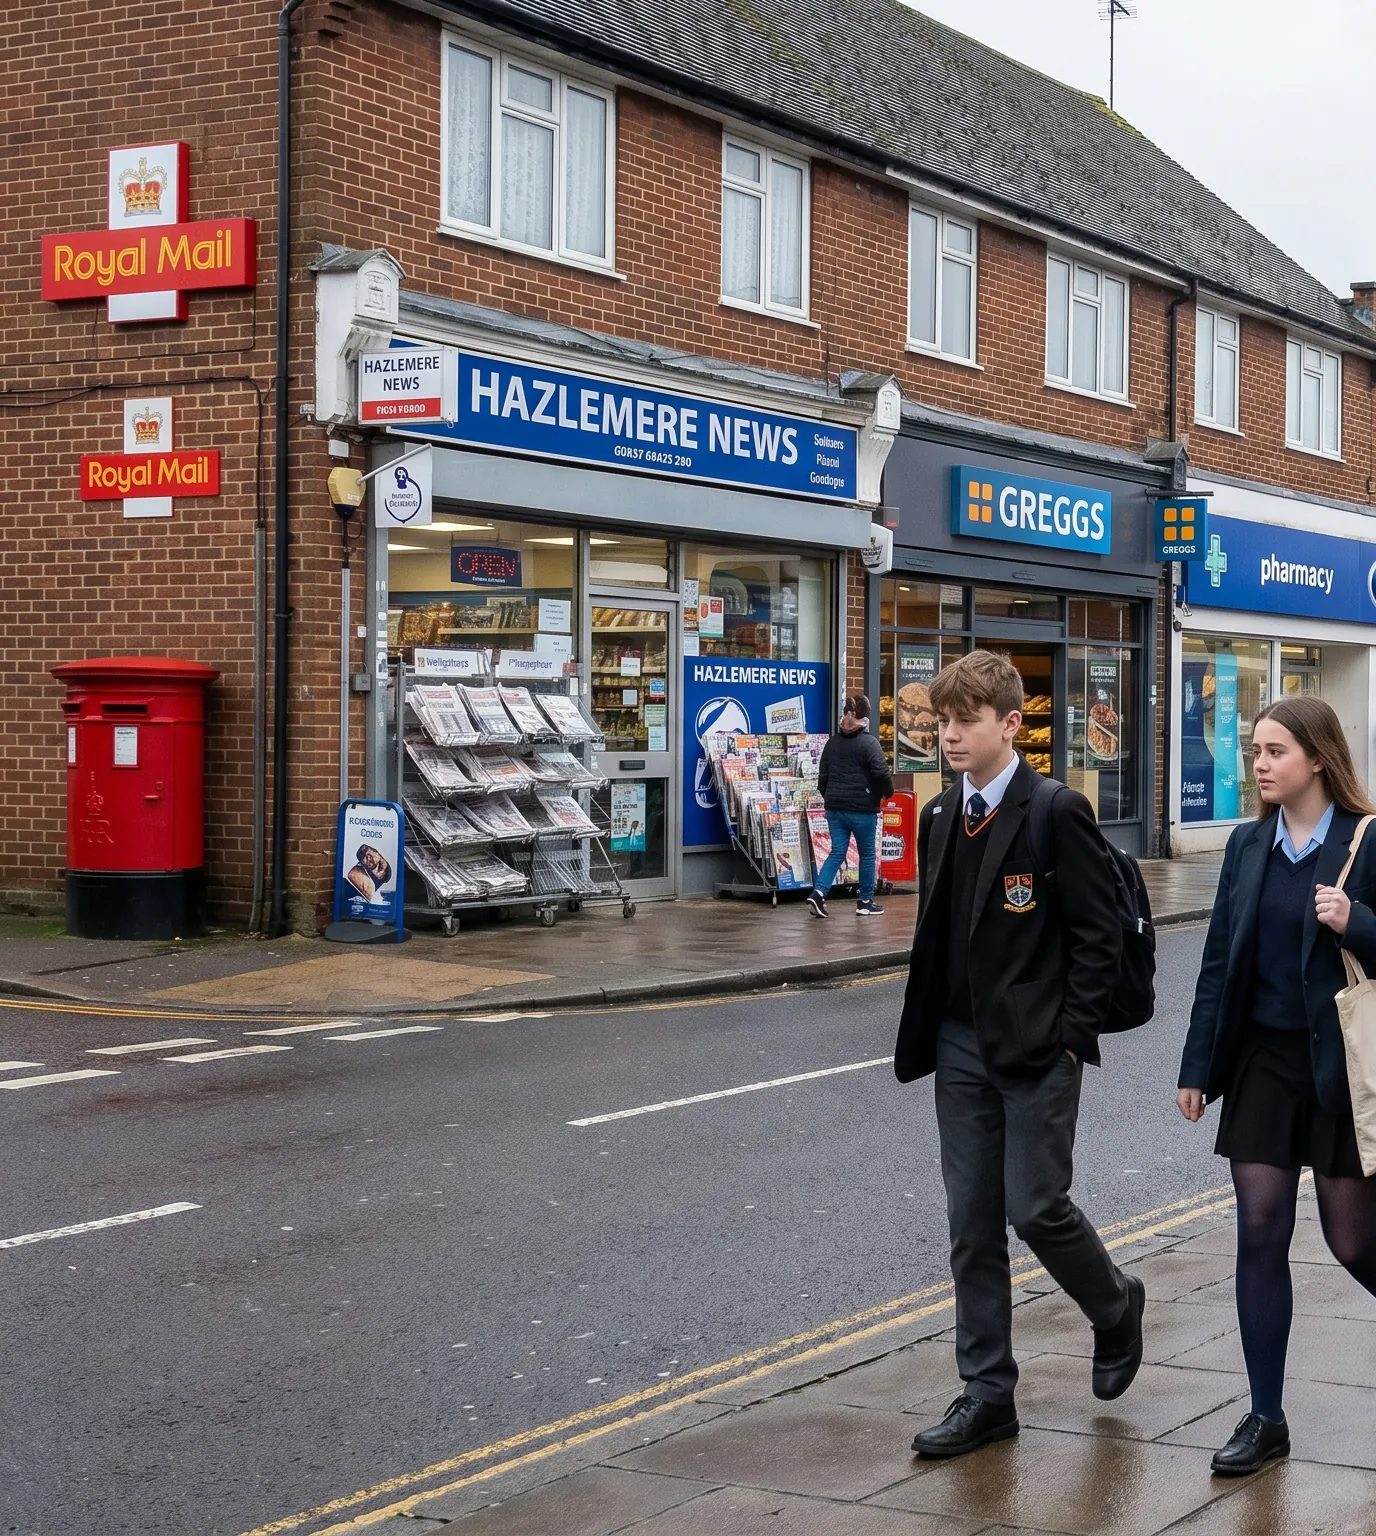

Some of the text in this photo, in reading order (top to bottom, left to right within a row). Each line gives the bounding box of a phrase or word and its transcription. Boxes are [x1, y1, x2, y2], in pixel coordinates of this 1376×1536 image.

[55, 229, 232, 286] Royal Mail
[364, 356, 440, 373] HAZLEMERE
[383, 376, 420, 391] NEWS
[471, 368, 798, 466] HAZLEMERE NEWS
[88, 456, 209, 493] Royal Mail
[999, 486, 1105, 540] GREGGS
[1260, 553, 1334, 595] pharmacy
[694, 665, 817, 686] HAZLEMERE NEWS
